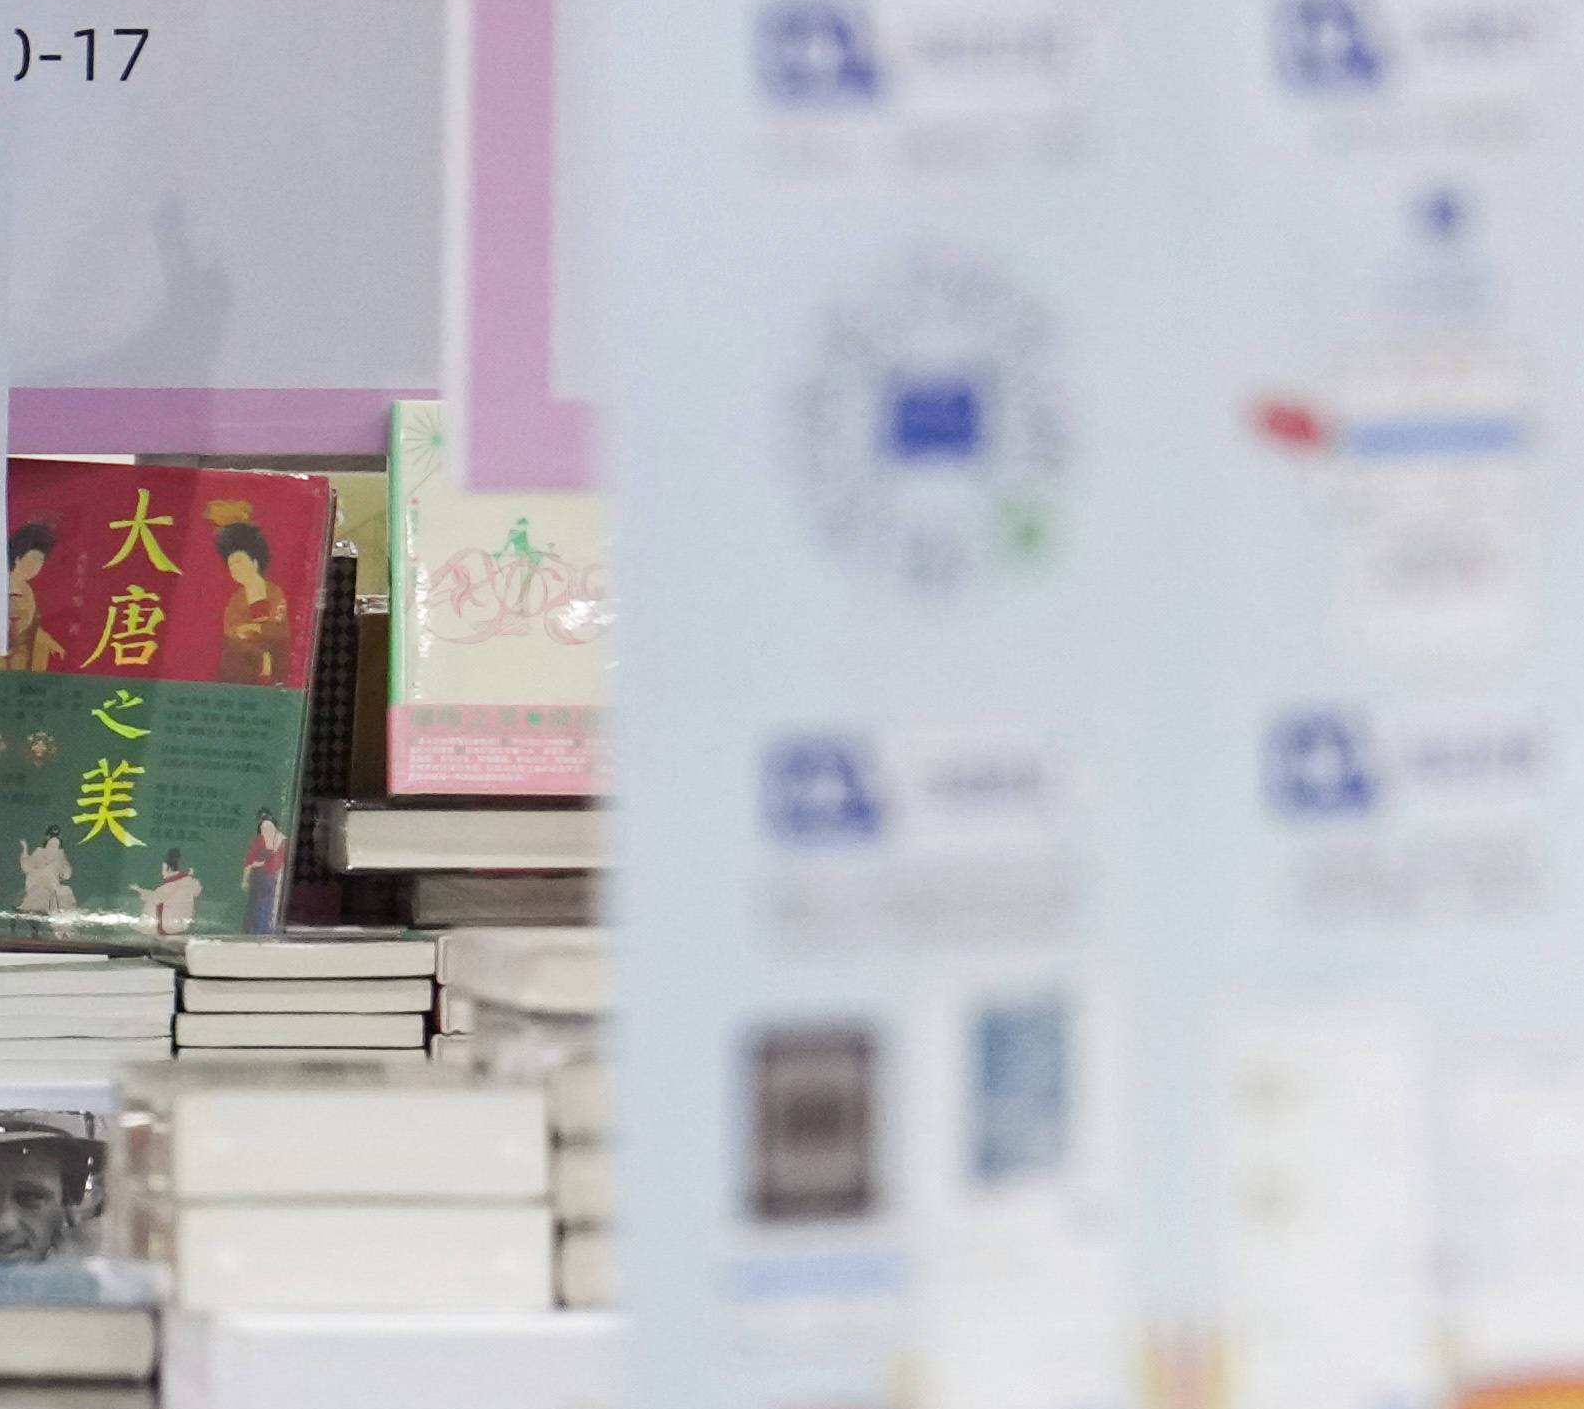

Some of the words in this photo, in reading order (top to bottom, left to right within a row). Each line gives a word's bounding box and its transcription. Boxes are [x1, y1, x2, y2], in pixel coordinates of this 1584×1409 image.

[14, 26, 151, 83] -17
[71, 486, 184, 849] 大唐之美
